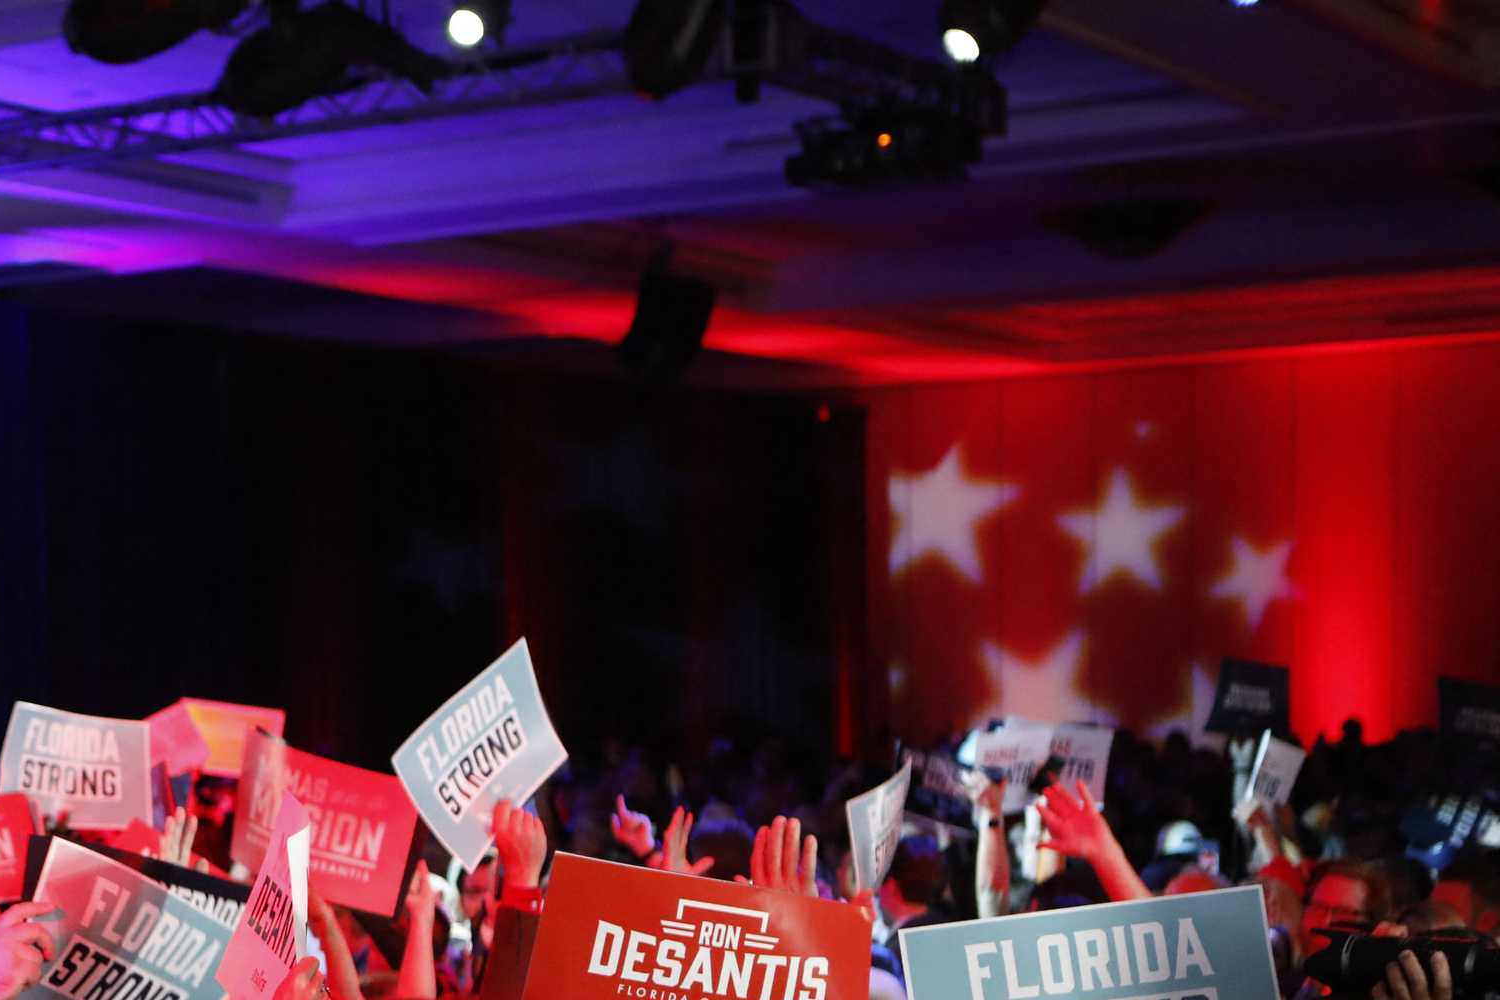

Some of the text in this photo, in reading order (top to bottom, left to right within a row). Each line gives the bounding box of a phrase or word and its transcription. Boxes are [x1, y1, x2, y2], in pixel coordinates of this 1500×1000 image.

[24, 717, 121, 763] FLORIDA
[417, 674, 514, 781] FLORIDA
[22, 759, 117, 797] STRONG
[438, 717, 522, 815] STRONG
[81, 874, 222, 989] FLORIDA
[698, 921, 741, 950] RON
